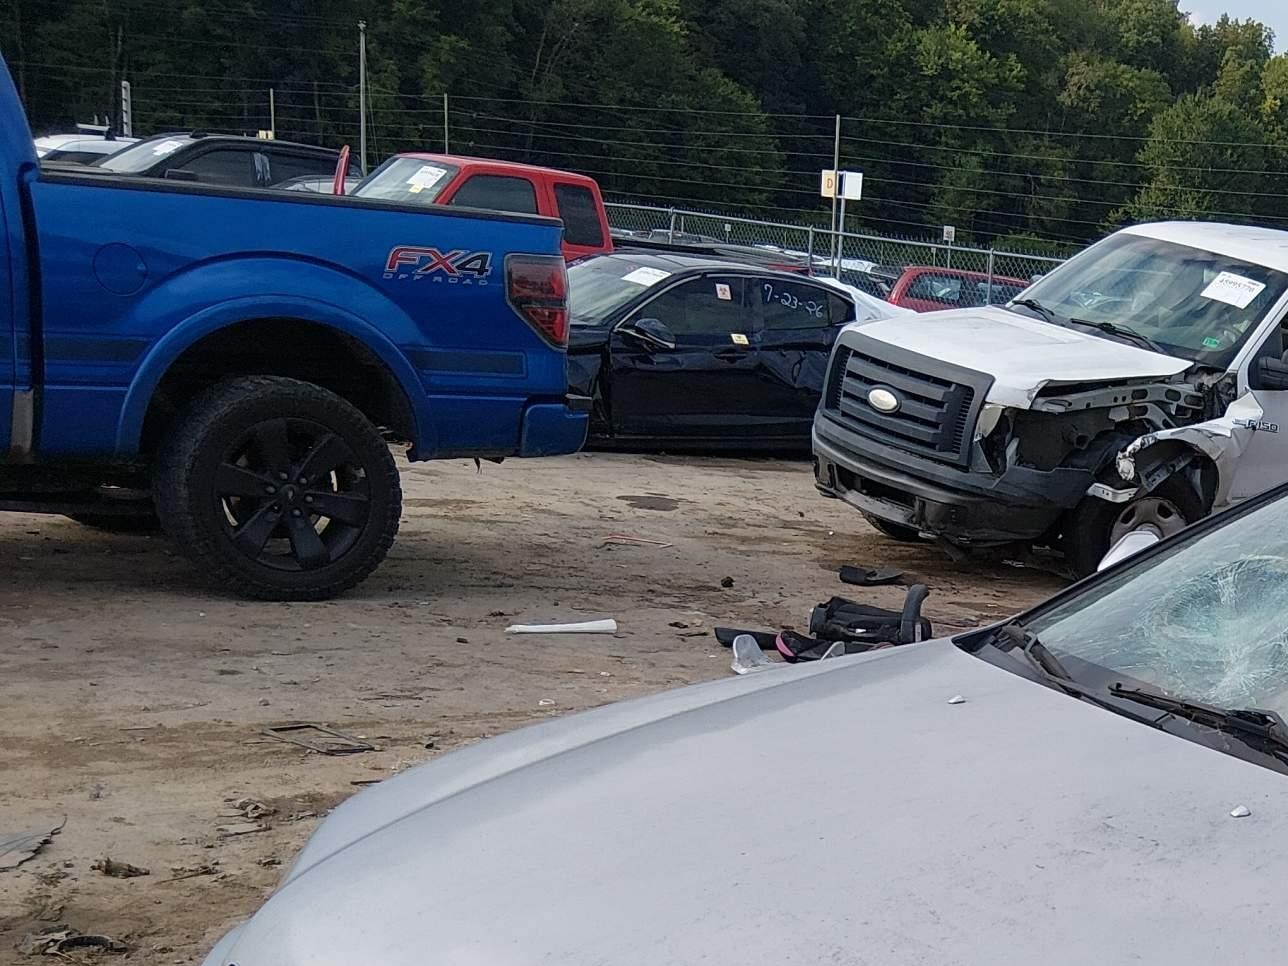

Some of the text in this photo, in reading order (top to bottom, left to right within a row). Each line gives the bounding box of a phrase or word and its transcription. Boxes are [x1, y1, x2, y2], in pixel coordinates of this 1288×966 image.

[826, 178, 834, 189] D
[384, 245, 493, 279] FX4
[382, 272, 489, 286] OFF ROAD
[763, 283, 824, 318] 7-23-26
